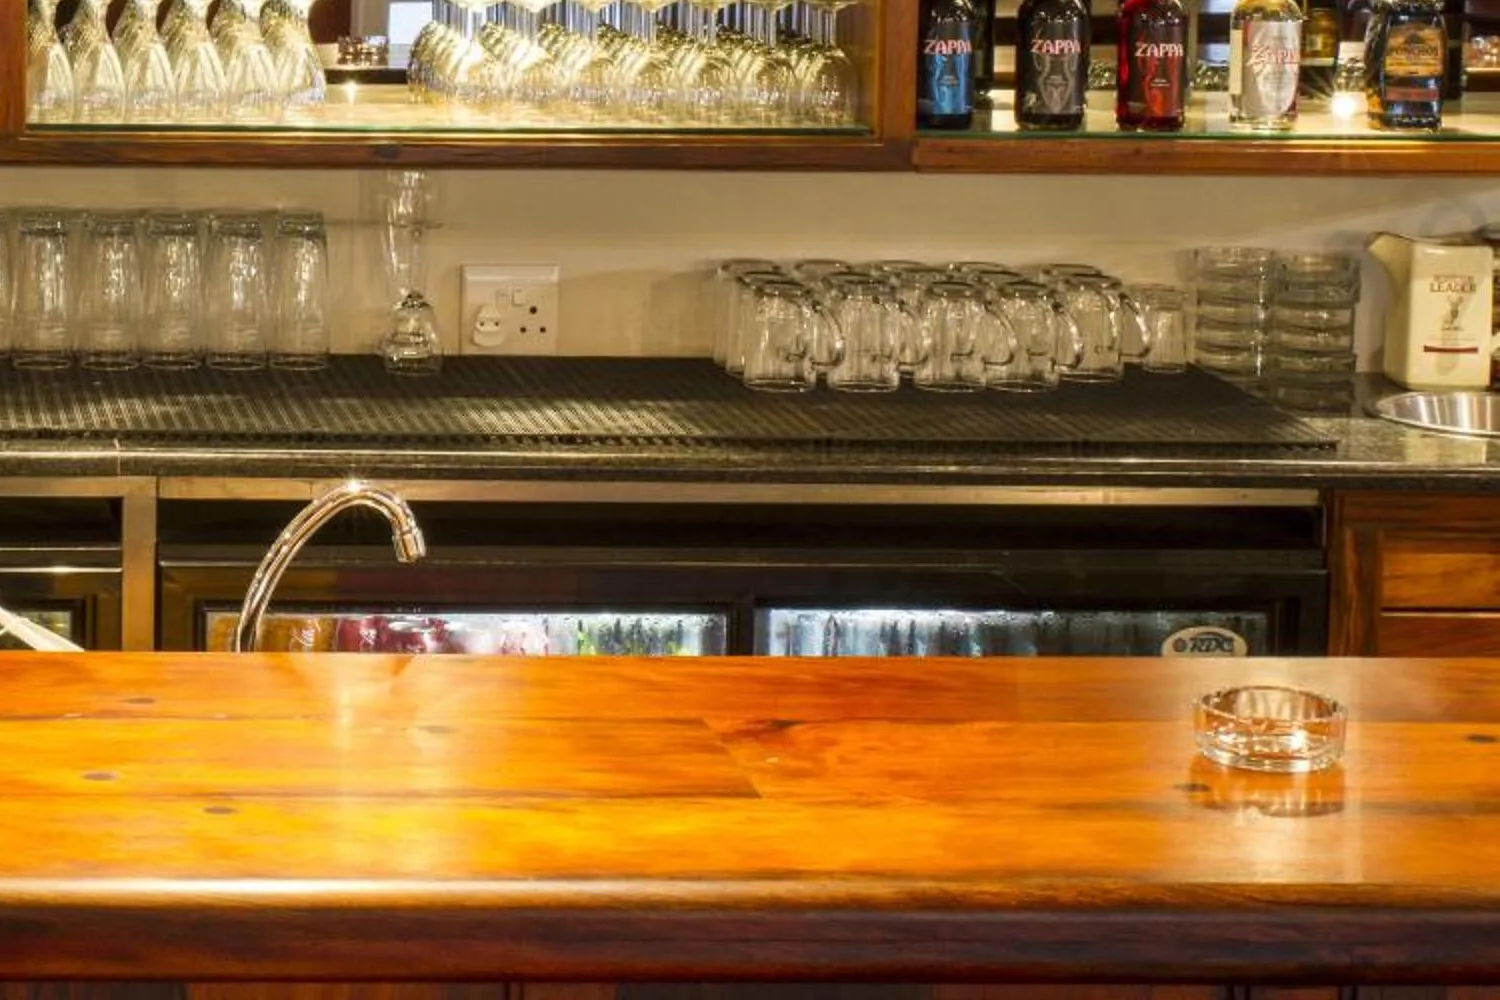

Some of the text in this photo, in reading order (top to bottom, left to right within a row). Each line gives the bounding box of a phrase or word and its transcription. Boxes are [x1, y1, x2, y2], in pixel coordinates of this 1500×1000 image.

[924, 40, 972, 55] ZAPPA
[1032, 40, 1080, 55] ZAPPA
[1135, 43, 1183, 57] ZAPPA
